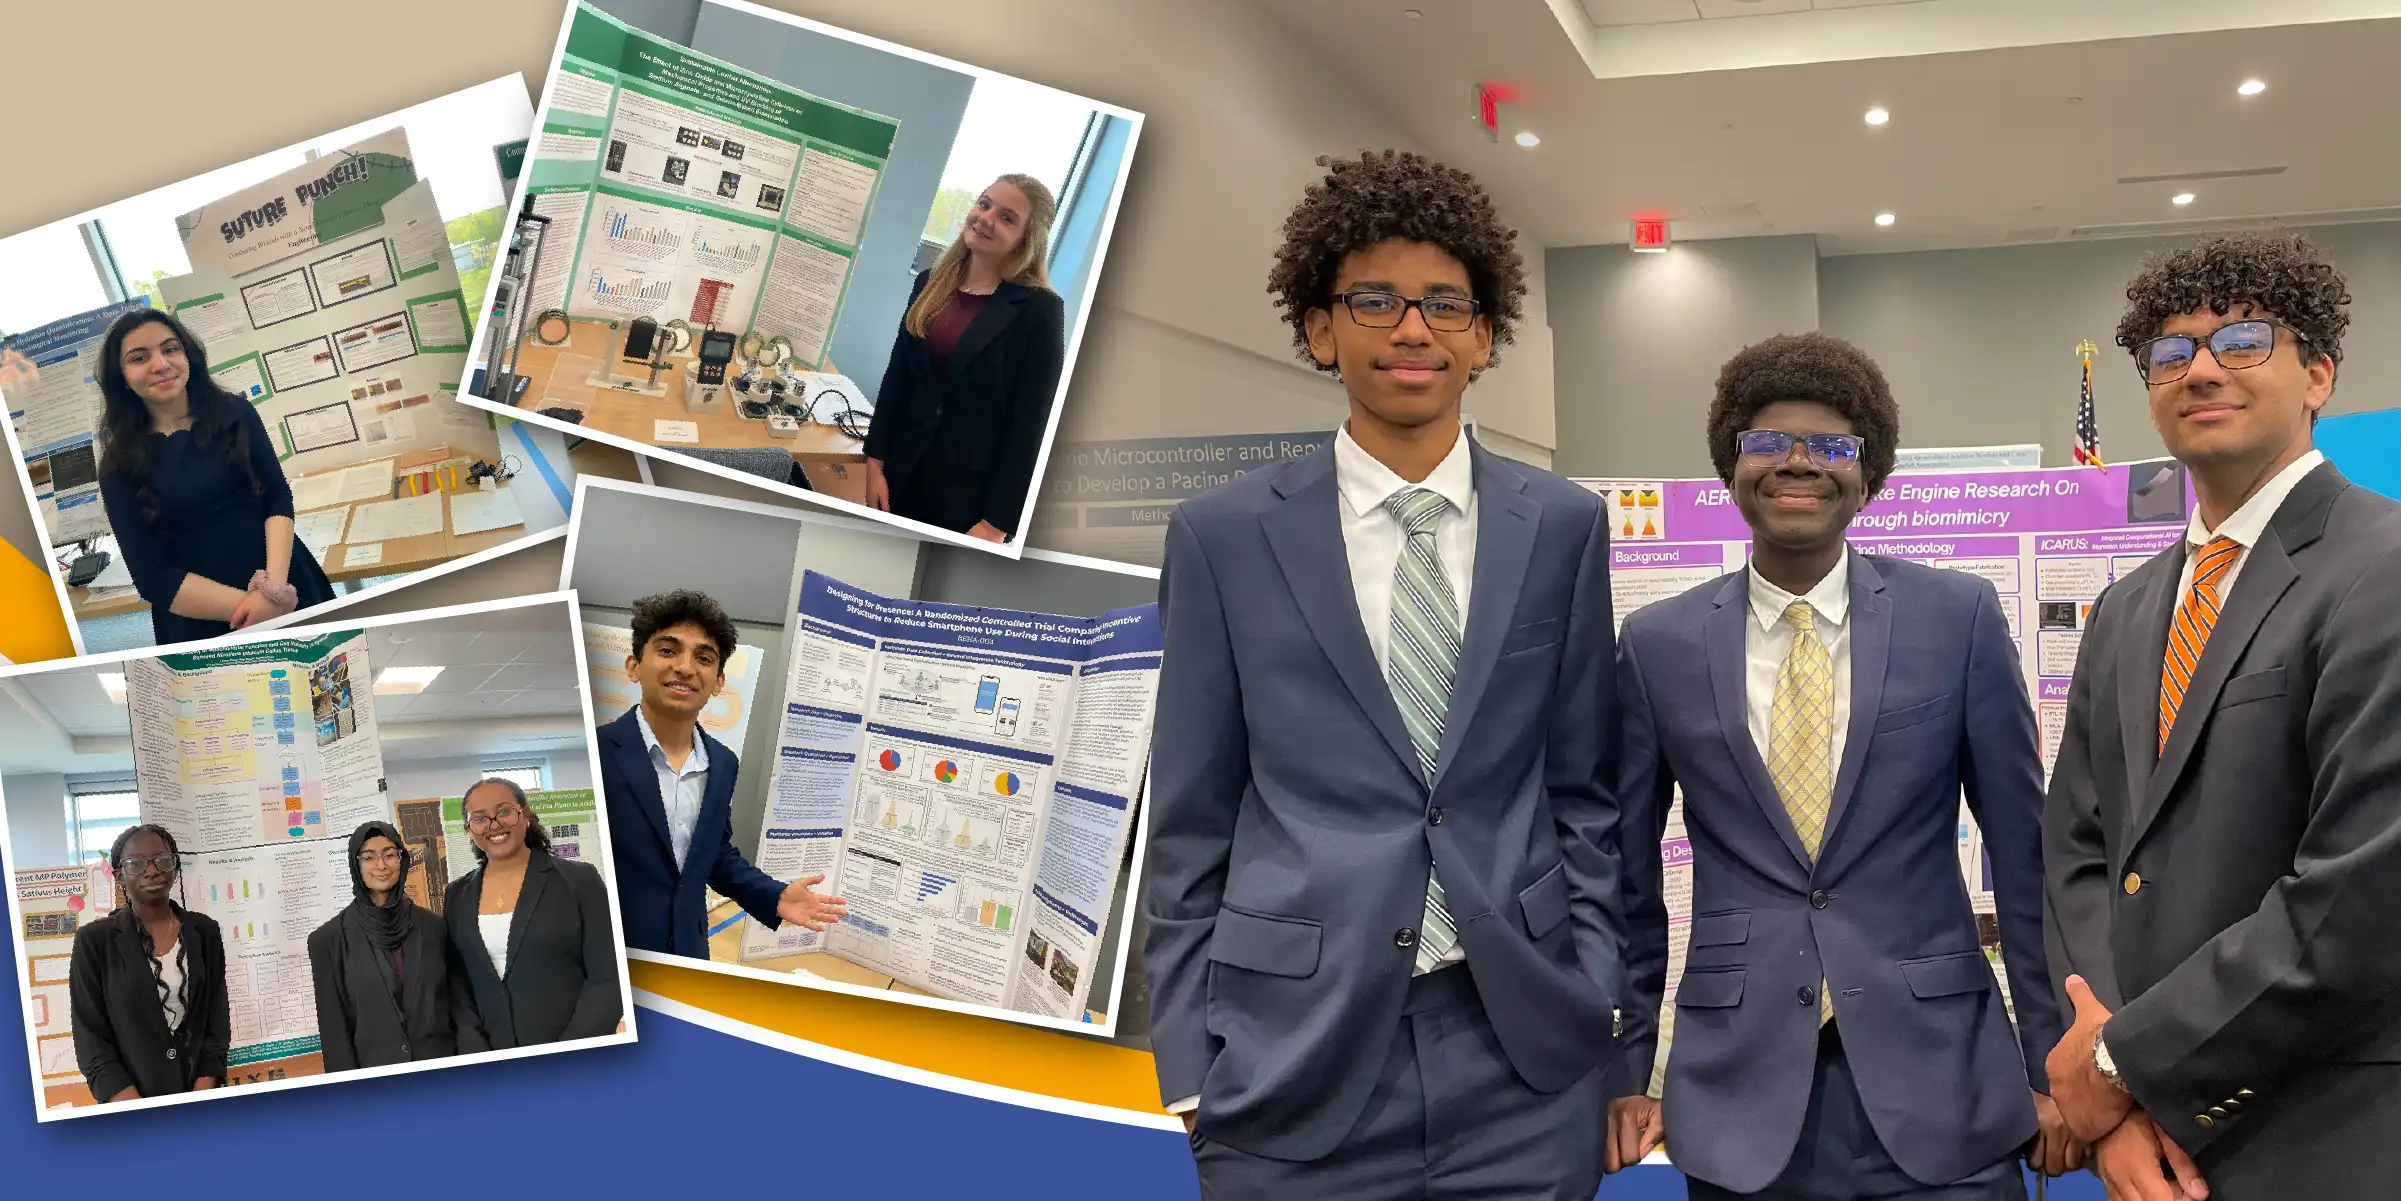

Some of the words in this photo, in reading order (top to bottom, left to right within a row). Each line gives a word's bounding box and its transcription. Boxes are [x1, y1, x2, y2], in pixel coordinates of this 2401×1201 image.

[640, 52, 651, 61] The
[714, 80, 725, 88] and
[220, 196, 287, 243] SUTURE
[295, 155, 369, 207] PUNCH!
[1094, 442, 1232, 466] Microcontroller
[1239, 441, 1274, 460] and
[1280, 441, 1320, 458] Rep
[1078, 473, 1149, 494] Develop
[1156, 477, 1165, 490] a
[1172, 471, 1229, 491] Pacing
[1695, 489, 1737, 506] AER
[1900, 483, 1960, 503] Engine
[1964, 480, 2050, 499] Research
[2054, 479, 2080, 497] On
[1911, 508, 2010, 528] biomimicry
[1878, 541, 1955, 556] Methodology
[2040, 537, 2089, 551] ICARUS:
[2119, 541, 2156, 549] Understanding
[1615, 549, 1679, 564] Background
[827, 586, 863, 607] Designing
[865, 600, 874, 609] for
[875, 604, 914, 616] Presence:
[915, 609, 922, 617] A
[924, 610, 980, 624] Randomized
[982, 615, 1031, 629] Controlled
[1034, 622, 1055, 632] Trial
[1102, 616, 1141, 630] Incentive
[846, 604, 882, 622] Structures
[894, 617, 926, 627] Reduce
[927, 621, 983, 634] Smartphone
[985, 626, 1003, 637] Use
[1004, 629, 1038, 641] During
[1040, 635, 1071, 645] Social
[50, 870, 86, 881] Polymer
[21, 887, 52, 897] Sativus
[53, 885, 82, 896] Height
